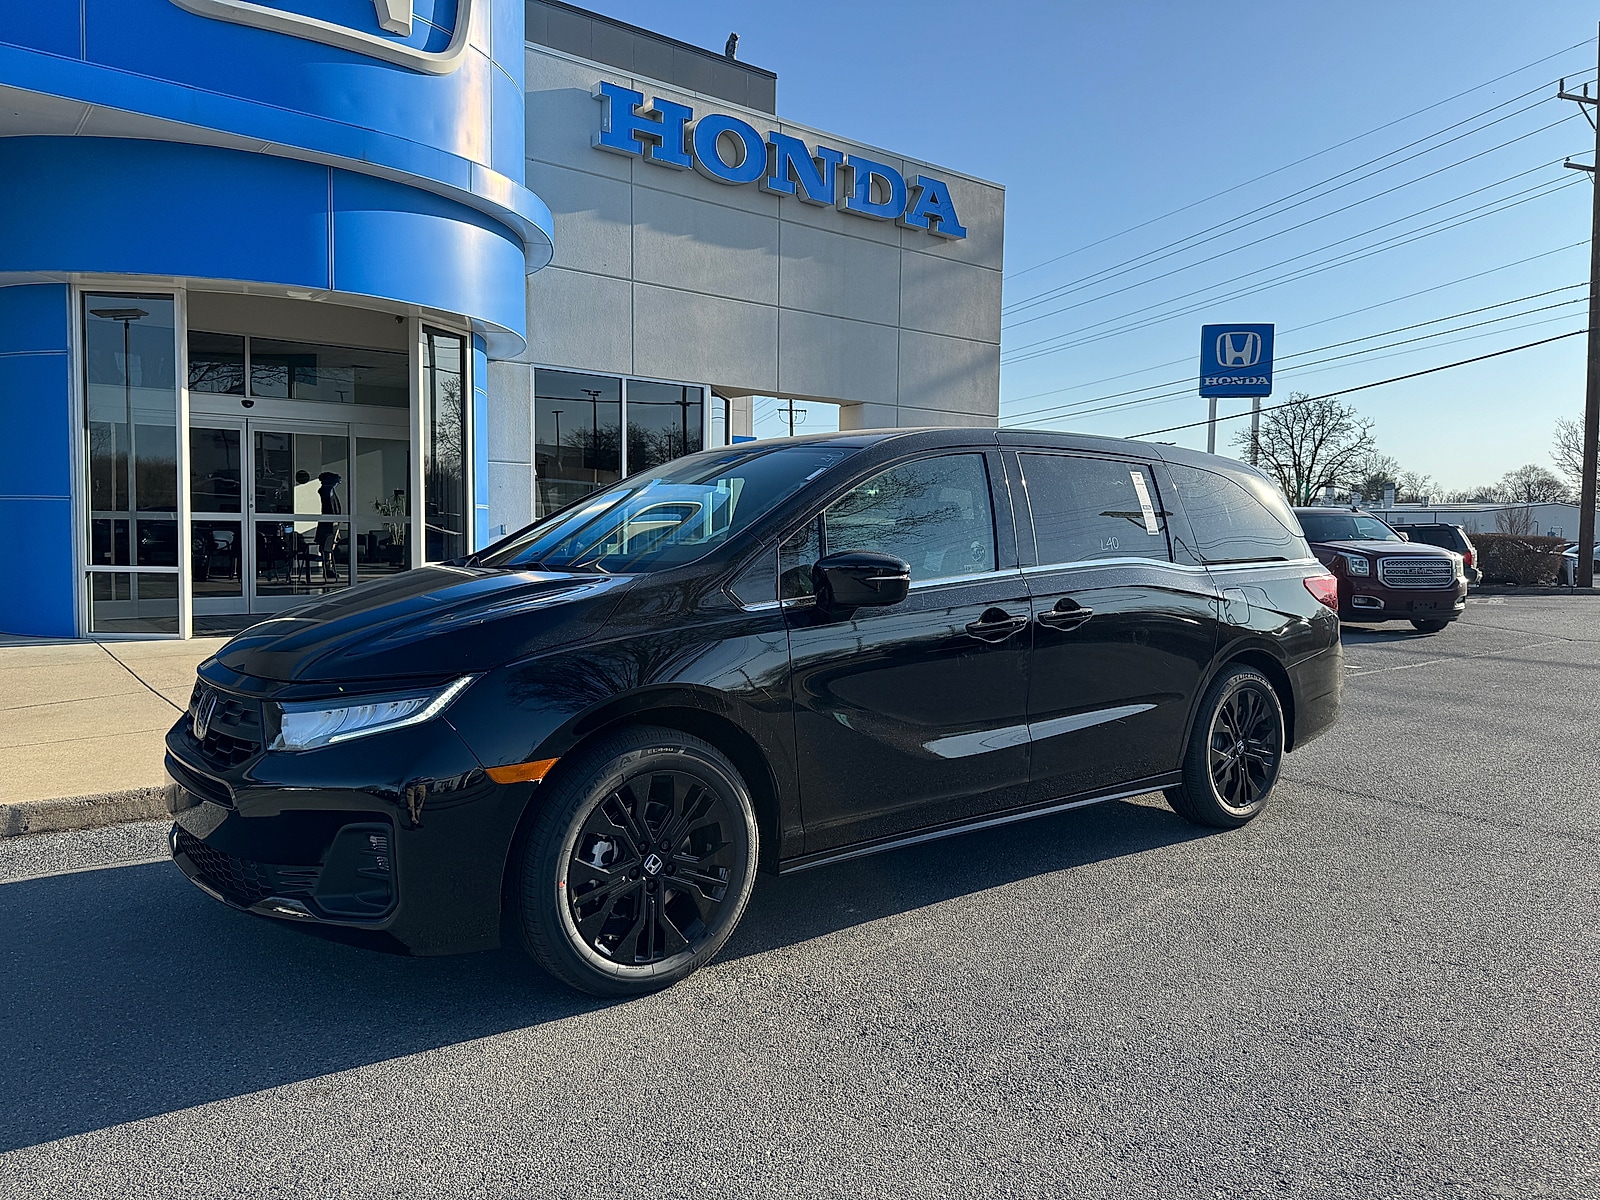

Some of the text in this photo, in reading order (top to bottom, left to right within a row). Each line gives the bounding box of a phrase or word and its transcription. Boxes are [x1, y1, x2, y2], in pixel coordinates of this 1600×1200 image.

[594, 81, 967, 240] HONDA
[1204, 377, 1270, 386] HONDA
[1100, 536, 1119, 551] L40
